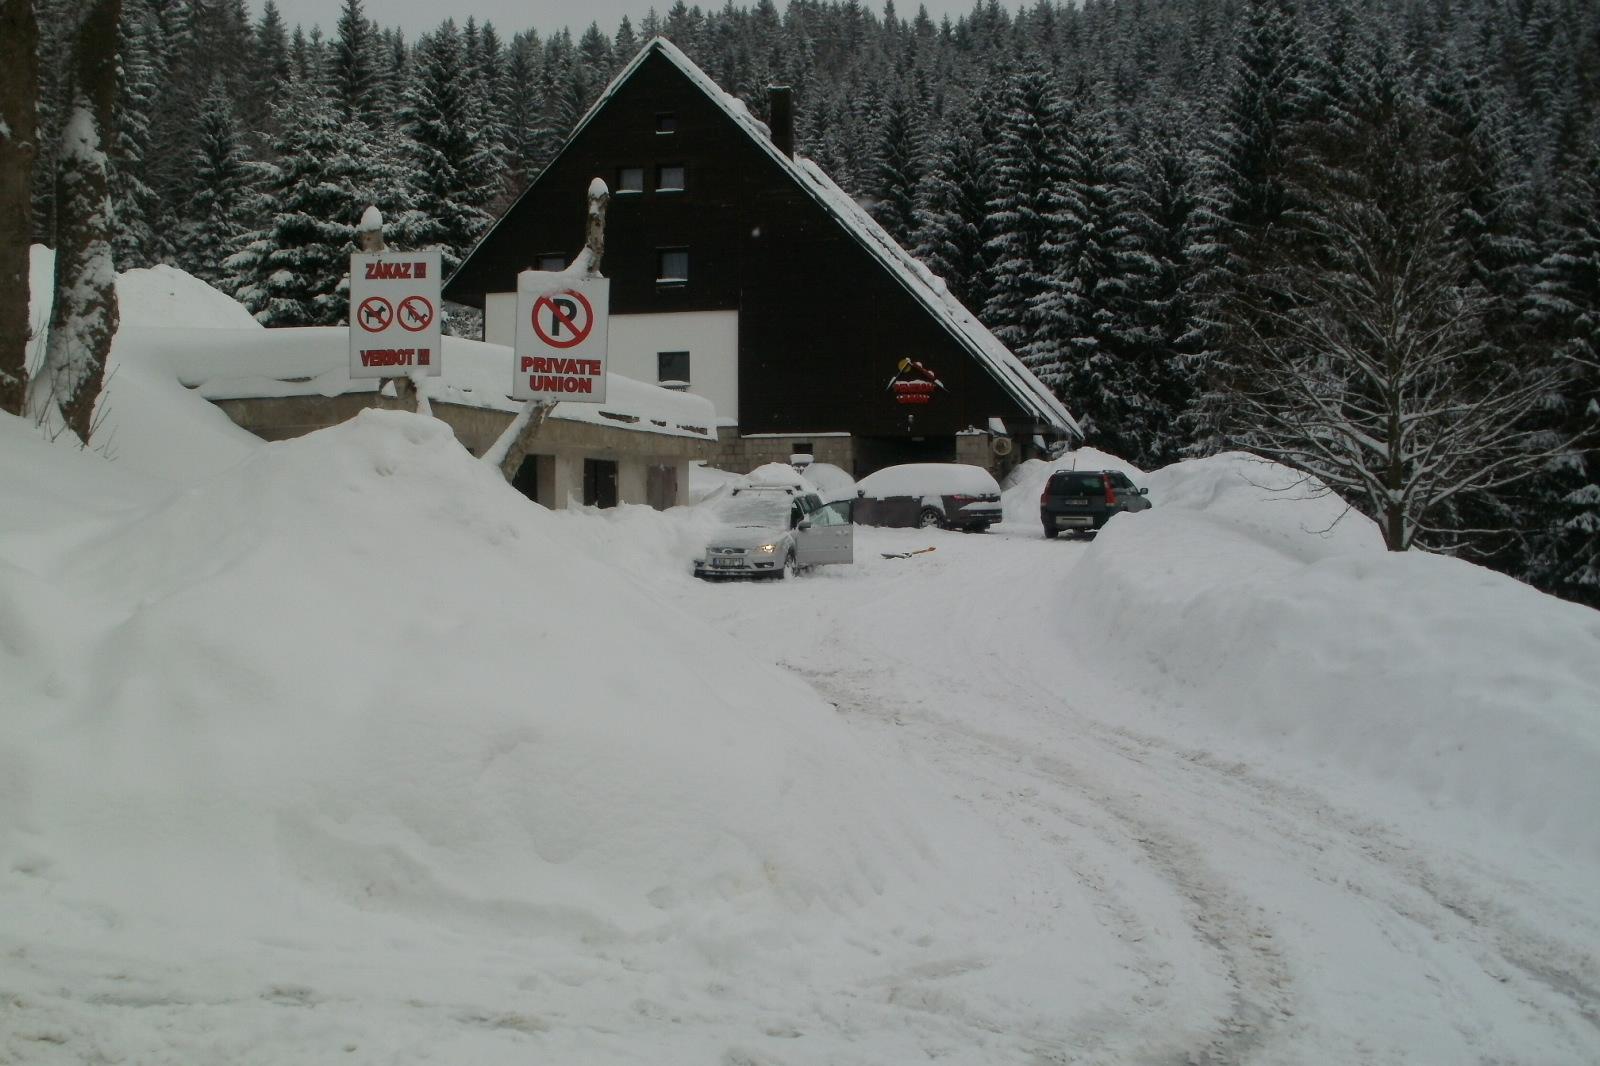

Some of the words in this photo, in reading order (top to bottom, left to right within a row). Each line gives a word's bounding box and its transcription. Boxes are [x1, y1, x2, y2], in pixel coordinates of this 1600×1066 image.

[365, 260, 411, 280] ZÁKAZ
[360, 349, 415, 367] VERBOT
[521, 356, 601, 376] PRIVATE
[529, 375, 592, 394] UNION
